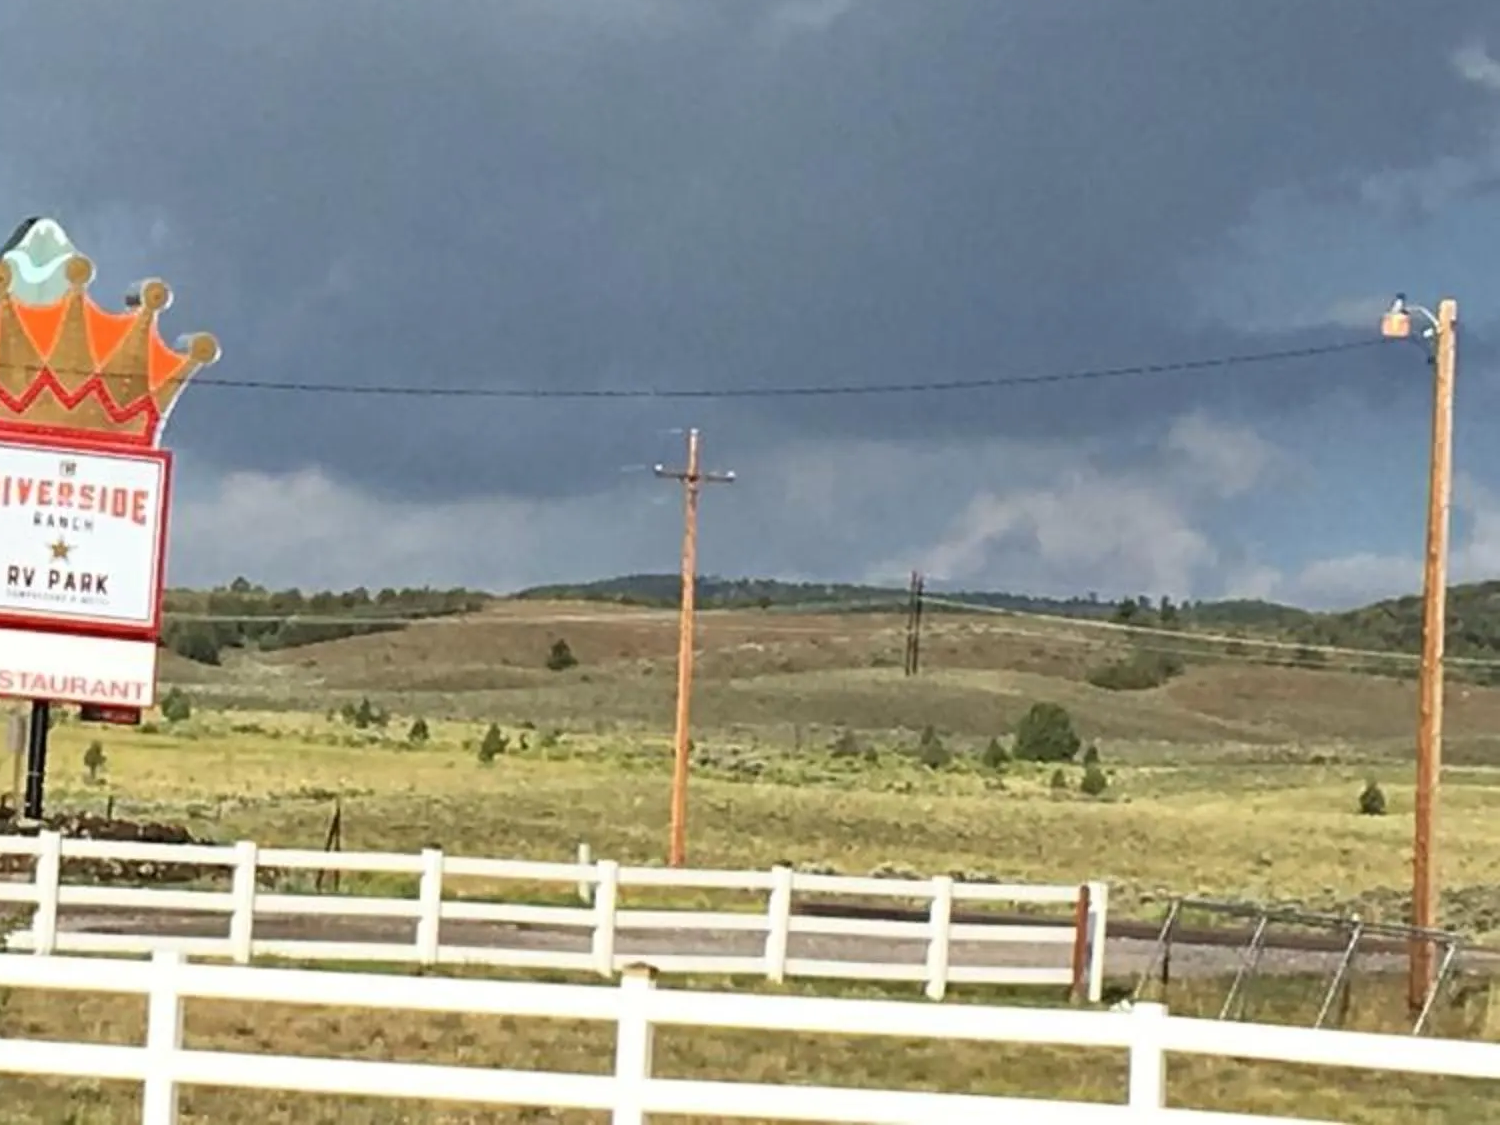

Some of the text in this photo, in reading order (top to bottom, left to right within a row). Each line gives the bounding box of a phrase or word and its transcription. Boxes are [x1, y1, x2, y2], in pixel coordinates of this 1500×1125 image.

[33, 511, 94, 531] RANCH
[7, 565, 109, 595] RV PARK
